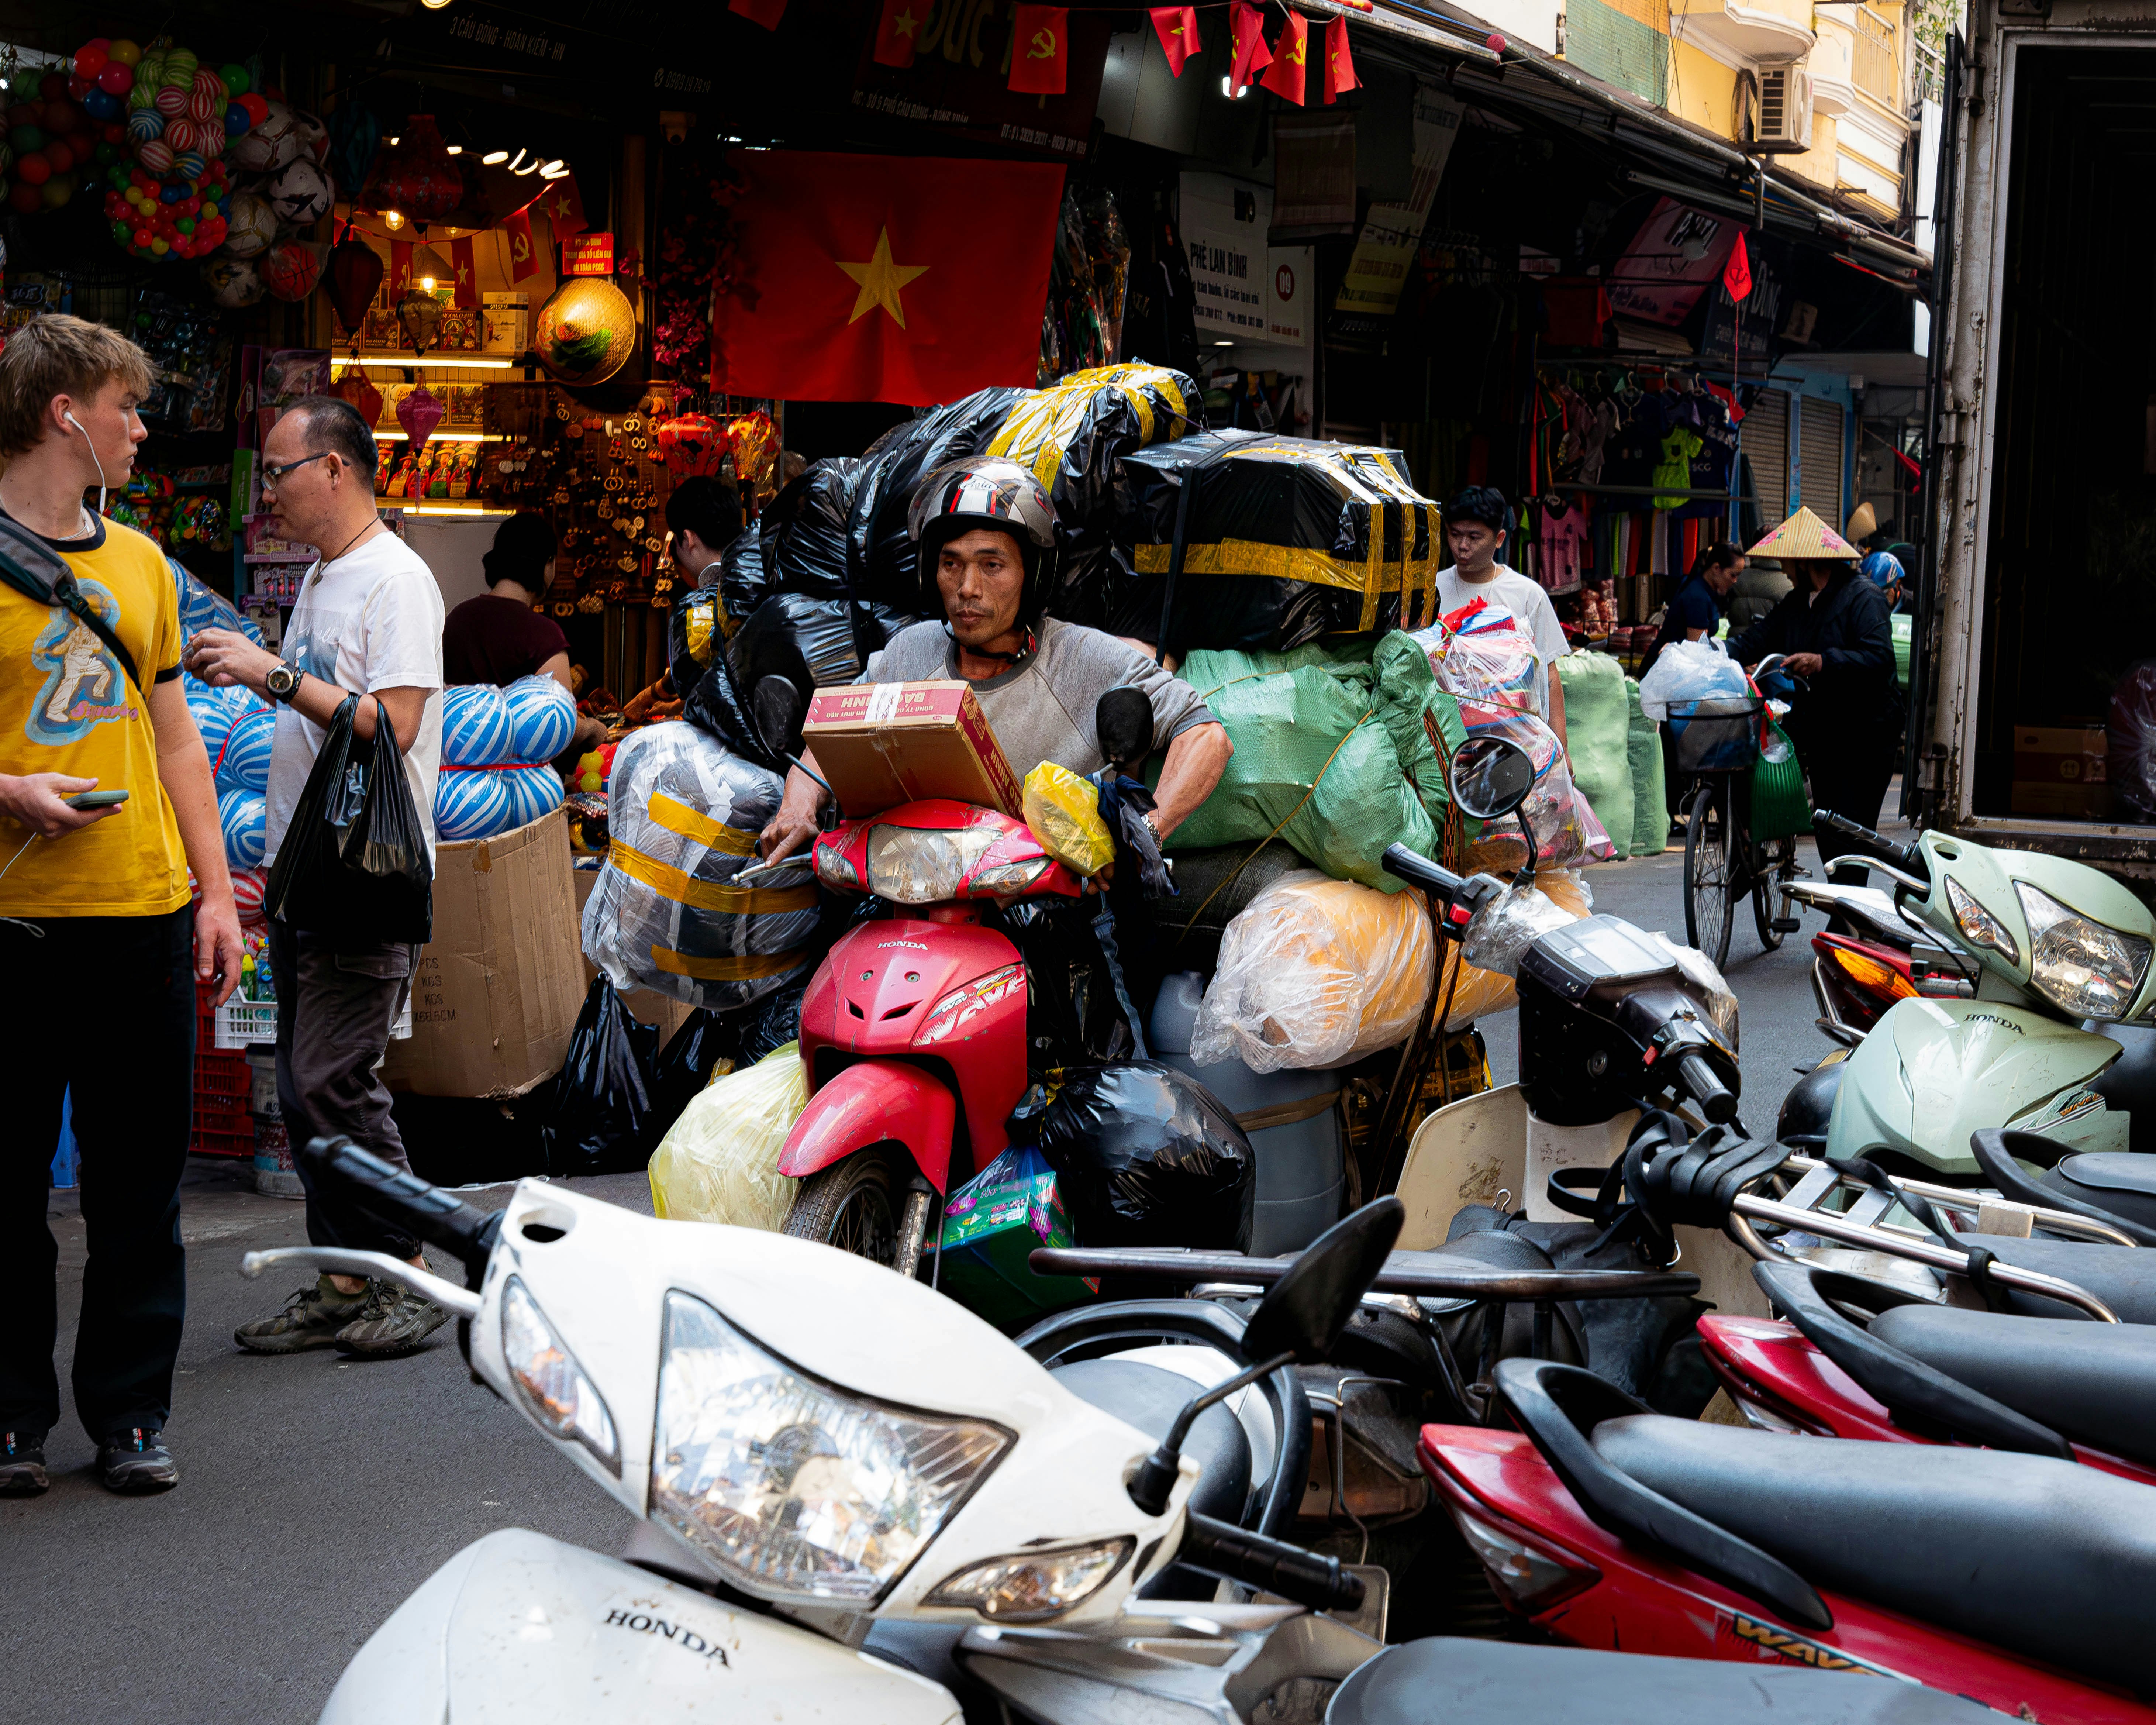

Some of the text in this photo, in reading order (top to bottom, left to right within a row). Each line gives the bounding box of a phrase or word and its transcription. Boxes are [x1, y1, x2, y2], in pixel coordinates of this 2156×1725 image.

[449, 16, 458, 35] 3
[552, 41, 566, 62] HN
[1209, 247, 1225, 274] LAN
[1279, 272, 1291, 294] 09
[841, 695, 868, 709] INH
[990, 748, 1010, 787] MINH
[877, 941, 928, 951] HONDA
[1963, 1013, 2026, 1036] HONDA
[604, 1608, 732, 1669] HONDA
